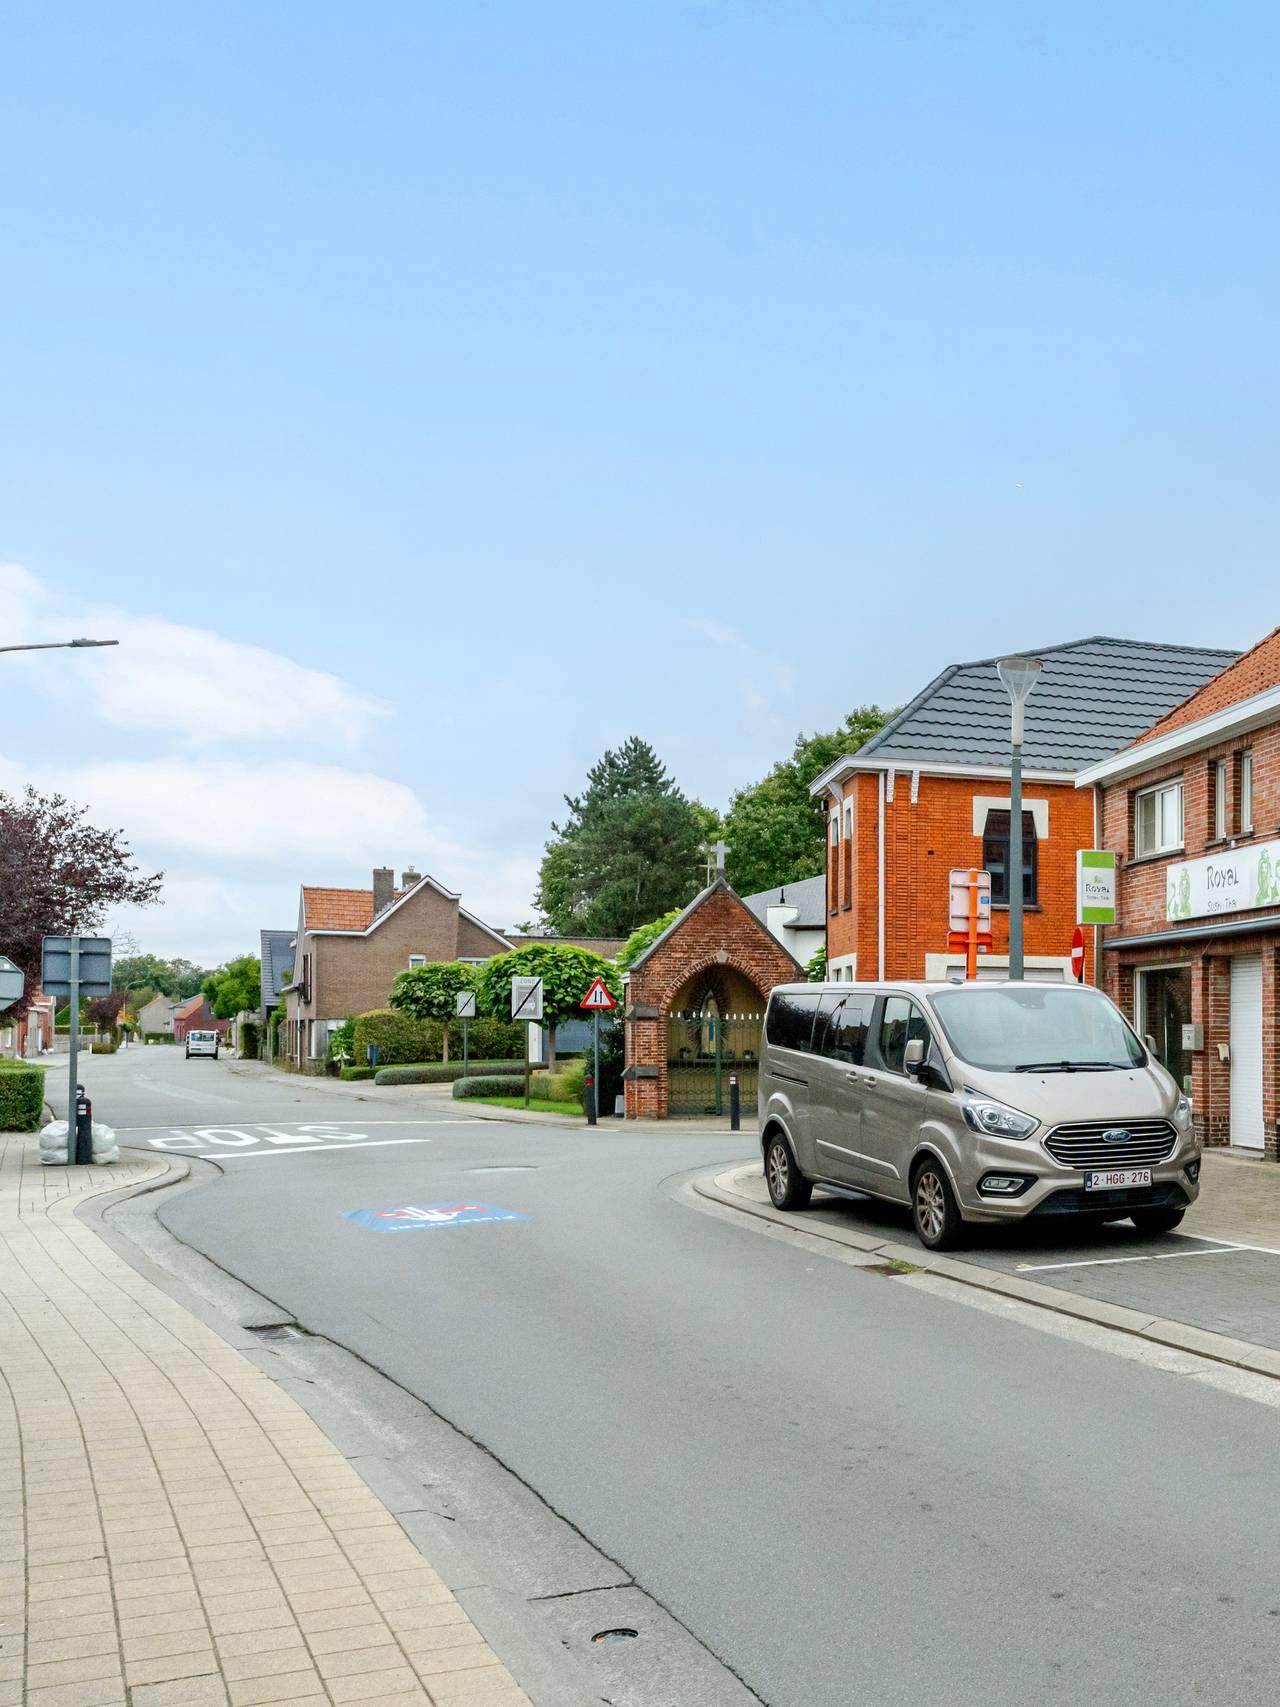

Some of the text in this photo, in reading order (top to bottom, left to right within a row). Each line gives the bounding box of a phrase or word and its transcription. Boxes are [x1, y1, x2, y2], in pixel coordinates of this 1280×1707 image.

[1206, 865, 1240, 890] Royal
[147, 1125, 369, 1149] STOP
[1093, 1171, 1150, 1186] 2-HGG-276
